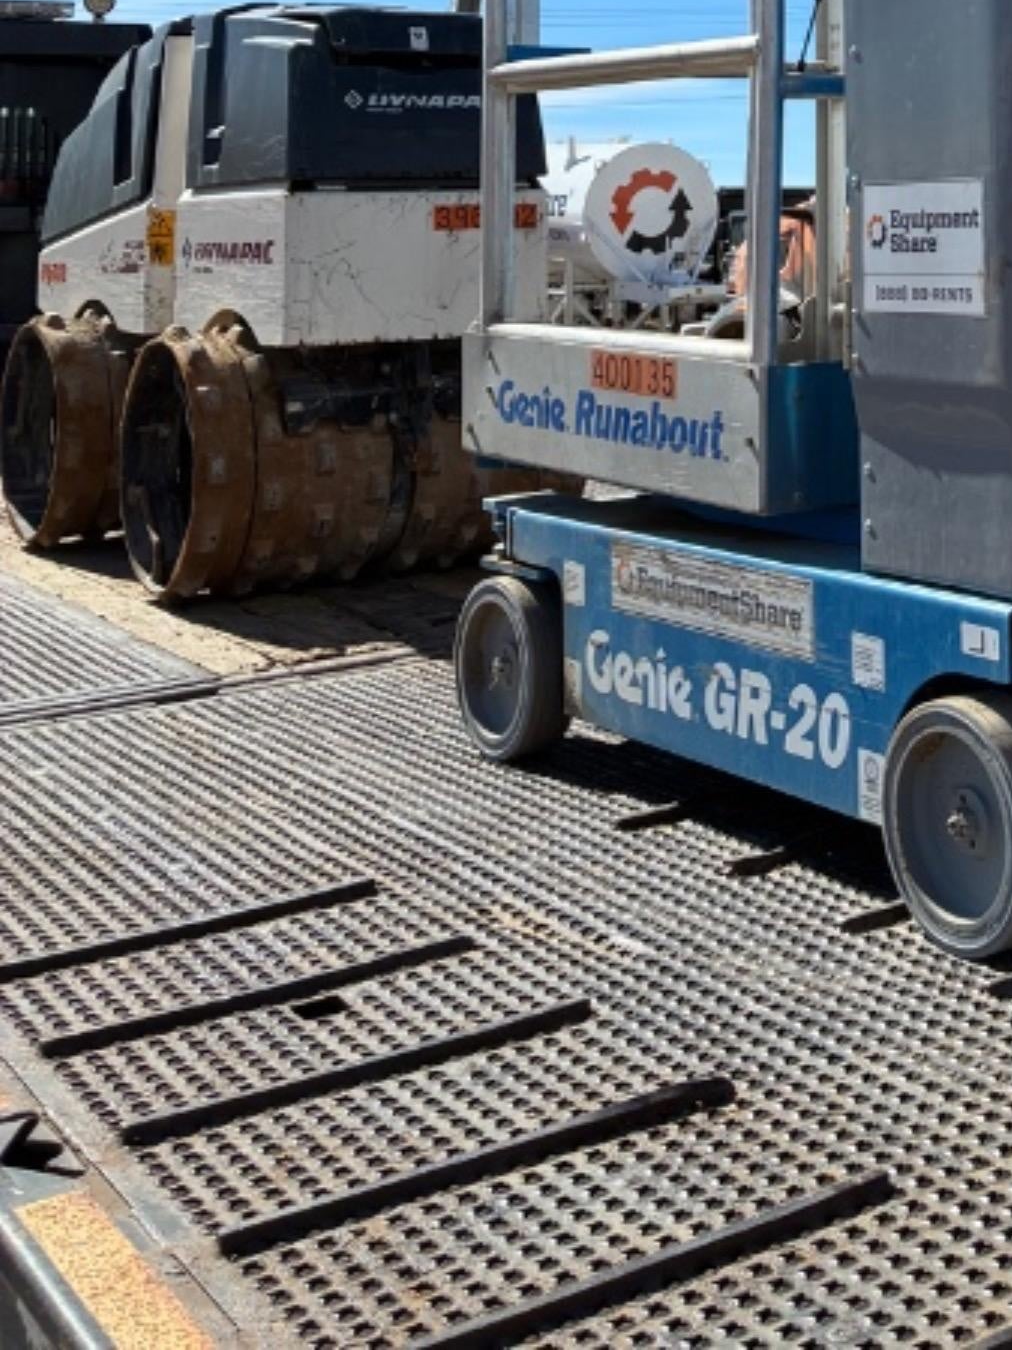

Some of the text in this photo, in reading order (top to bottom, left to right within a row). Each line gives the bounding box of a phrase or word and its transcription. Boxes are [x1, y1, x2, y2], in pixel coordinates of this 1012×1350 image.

[367, 94, 481, 110] DYNAPA
[889, 208, 980, 233] Equipment
[890, 233, 938, 253] Share
[592, 352, 675, 398] 400135
[498, 379, 725, 461] Genie Runabout
[585, 629, 693, 722] Genie
[704, 662, 851, 770] GR-20
